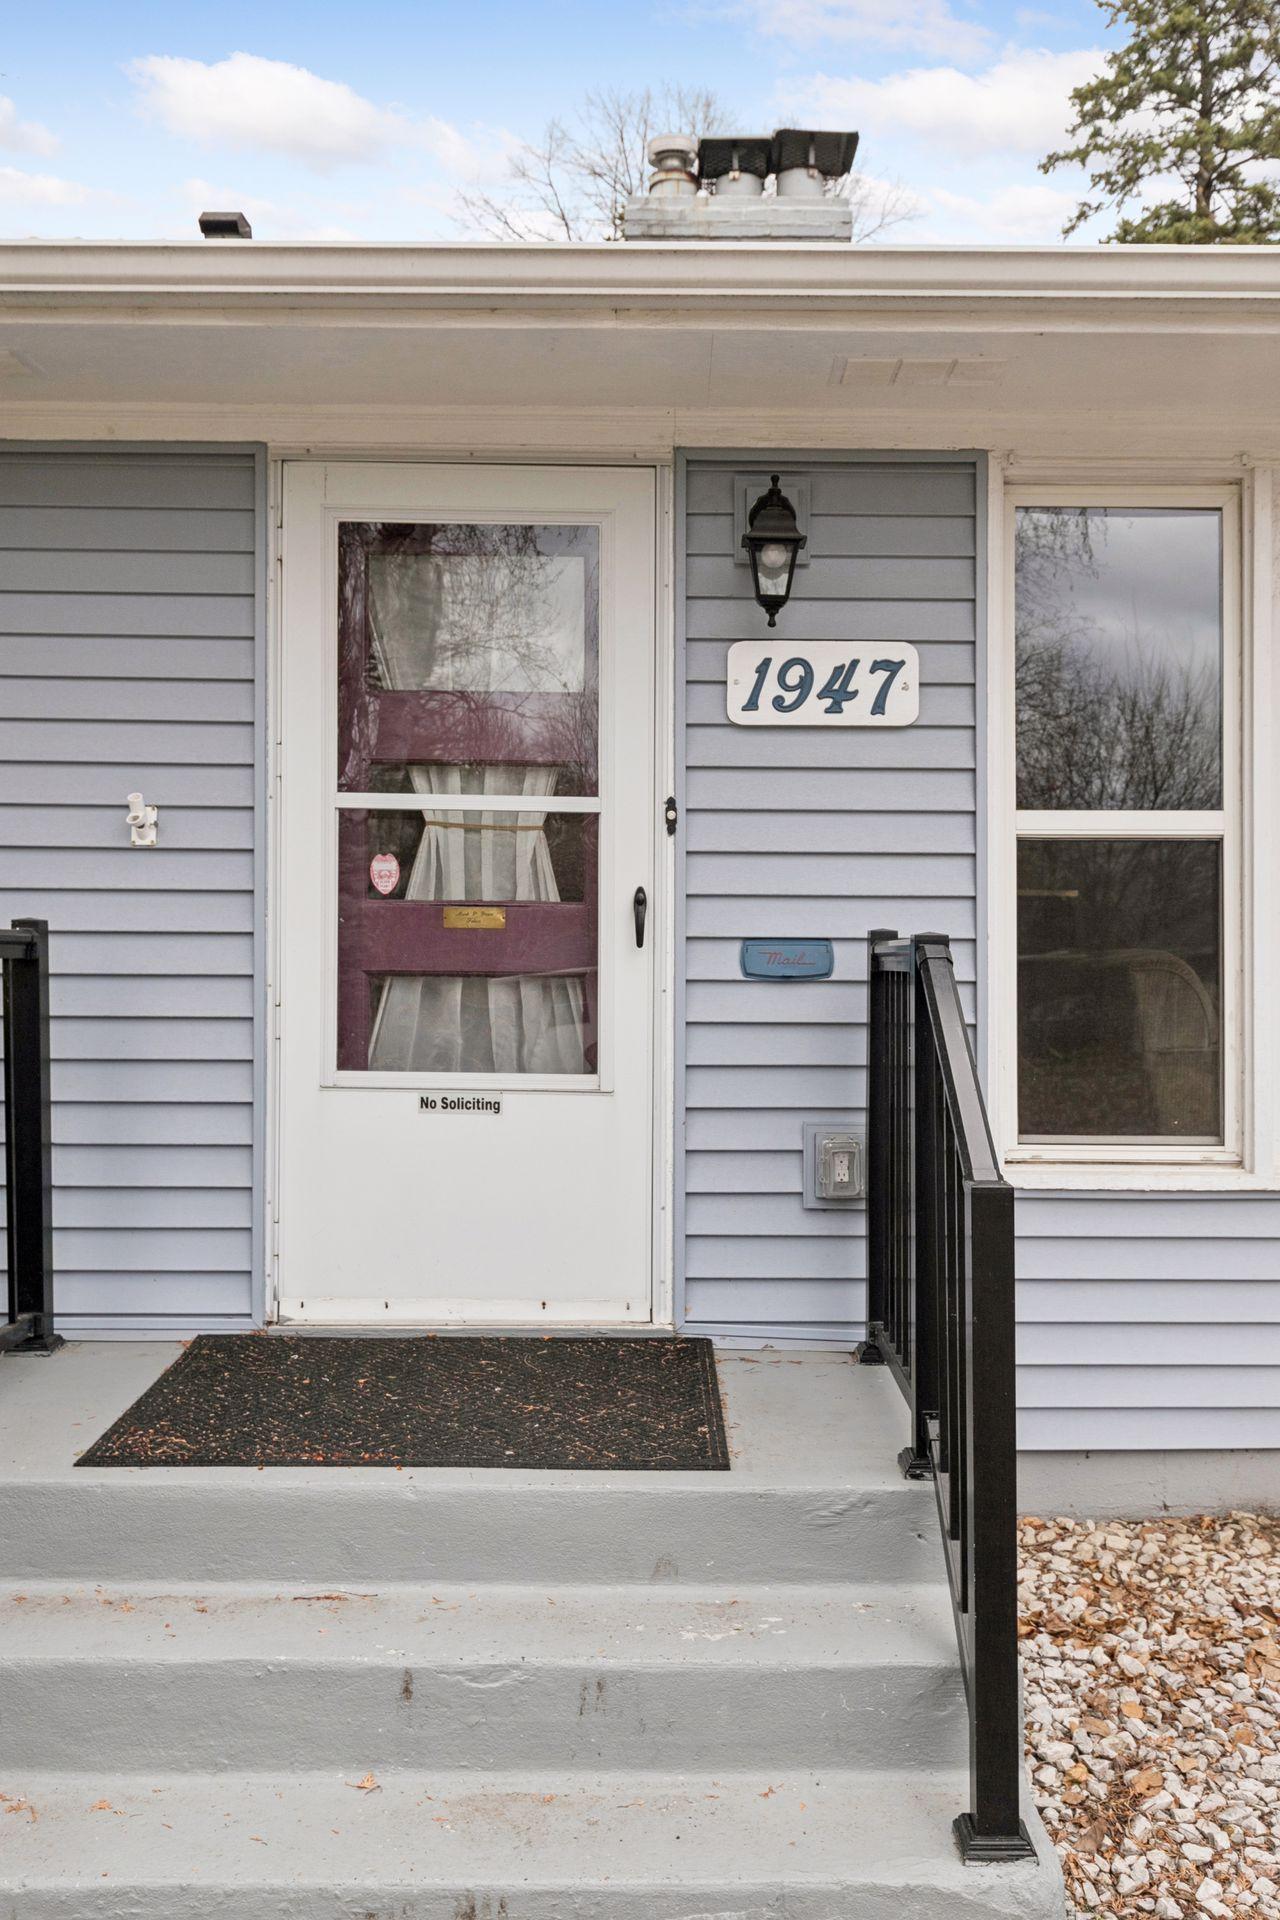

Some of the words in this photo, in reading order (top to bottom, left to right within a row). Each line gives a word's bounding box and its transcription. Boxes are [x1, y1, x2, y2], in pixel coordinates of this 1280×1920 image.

[741, 656, 906, 715] 1947
[758, 950, 816, 966] Mail
[420, 1096, 437, 1109] No
[440, 1096, 501, 1114] Soliciting
